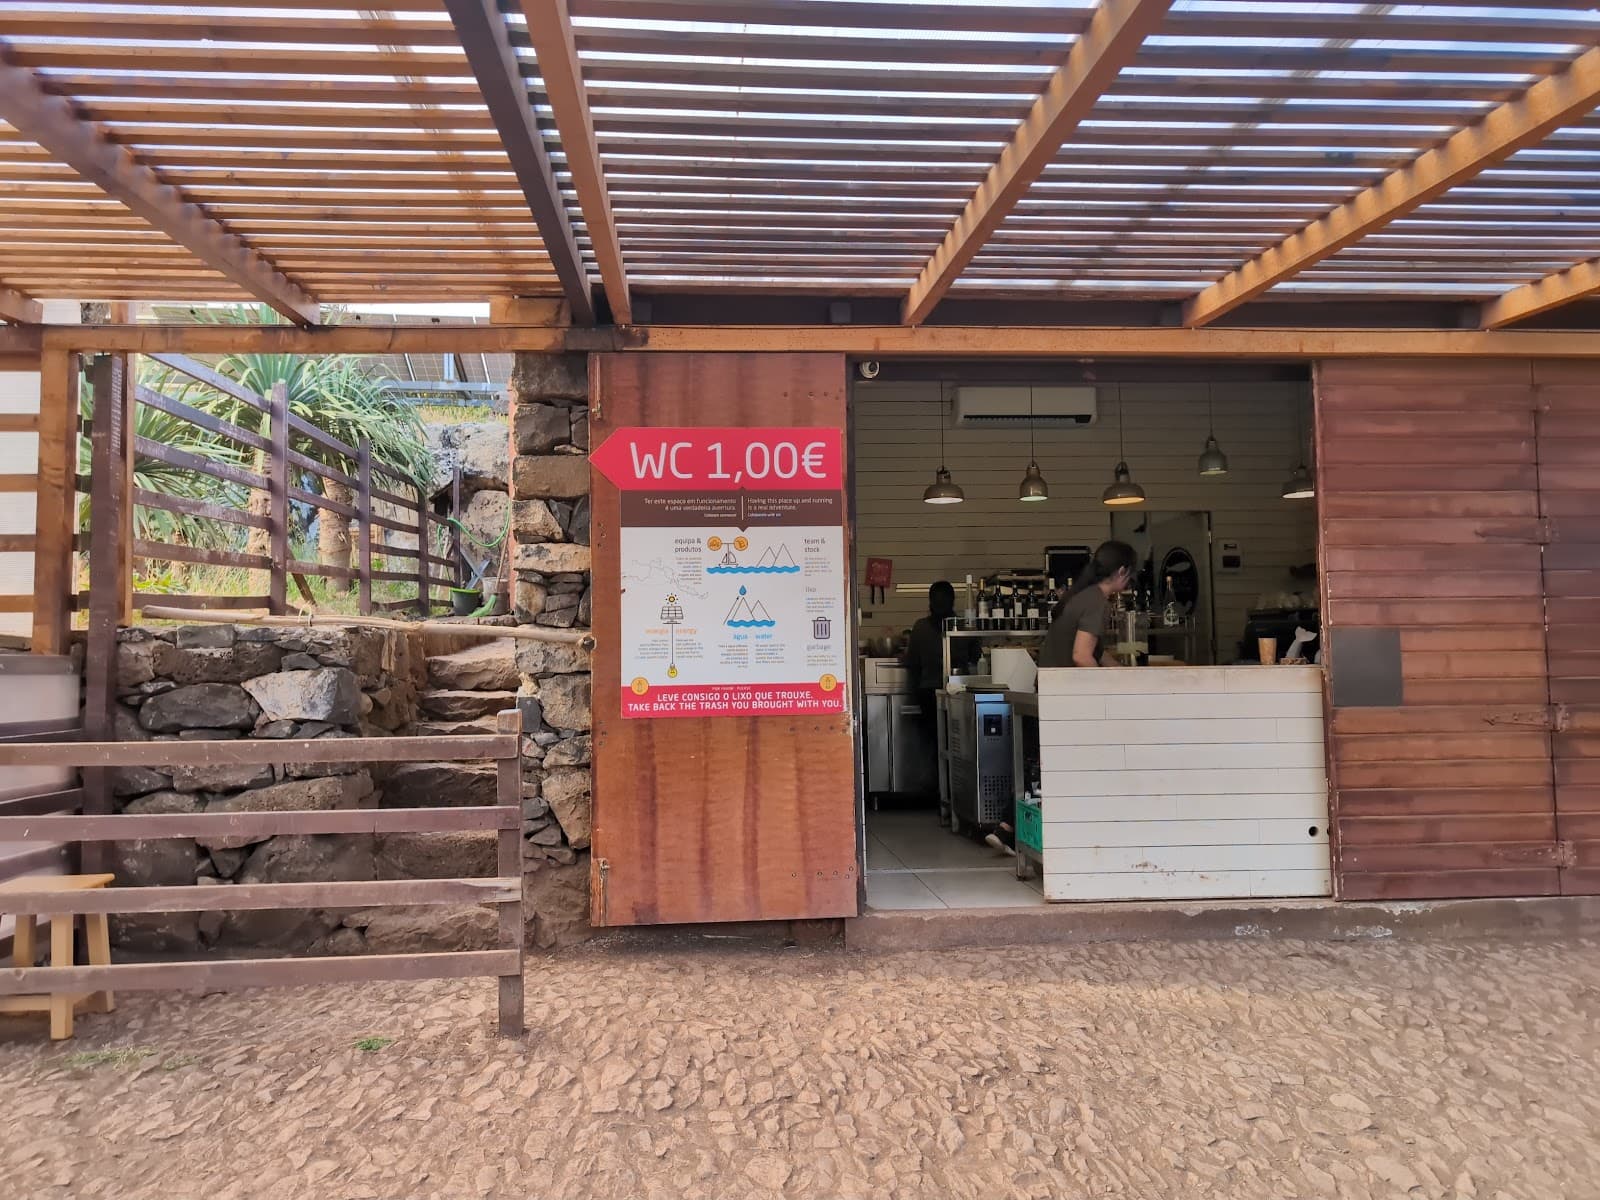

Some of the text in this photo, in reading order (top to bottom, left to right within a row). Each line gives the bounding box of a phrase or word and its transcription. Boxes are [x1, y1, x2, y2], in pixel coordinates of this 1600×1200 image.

[630, 441, 827, 484] WC 1,00€
[747, 497, 766, 505] Having
[778, 497, 793, 505] place
[793, 497, 801, 505] up
[812, 497, 833, 505] running
[674, 537, 696, 545] equipa
[755, 632, 773, 640] water
[657, 690, 813, 702] LEVE CONSIGO O LIXO QUE TROUXE.
[628, 699, 842, 712] TAKE BACK THE TRASH YOU BROUGHT WITH YOU.
